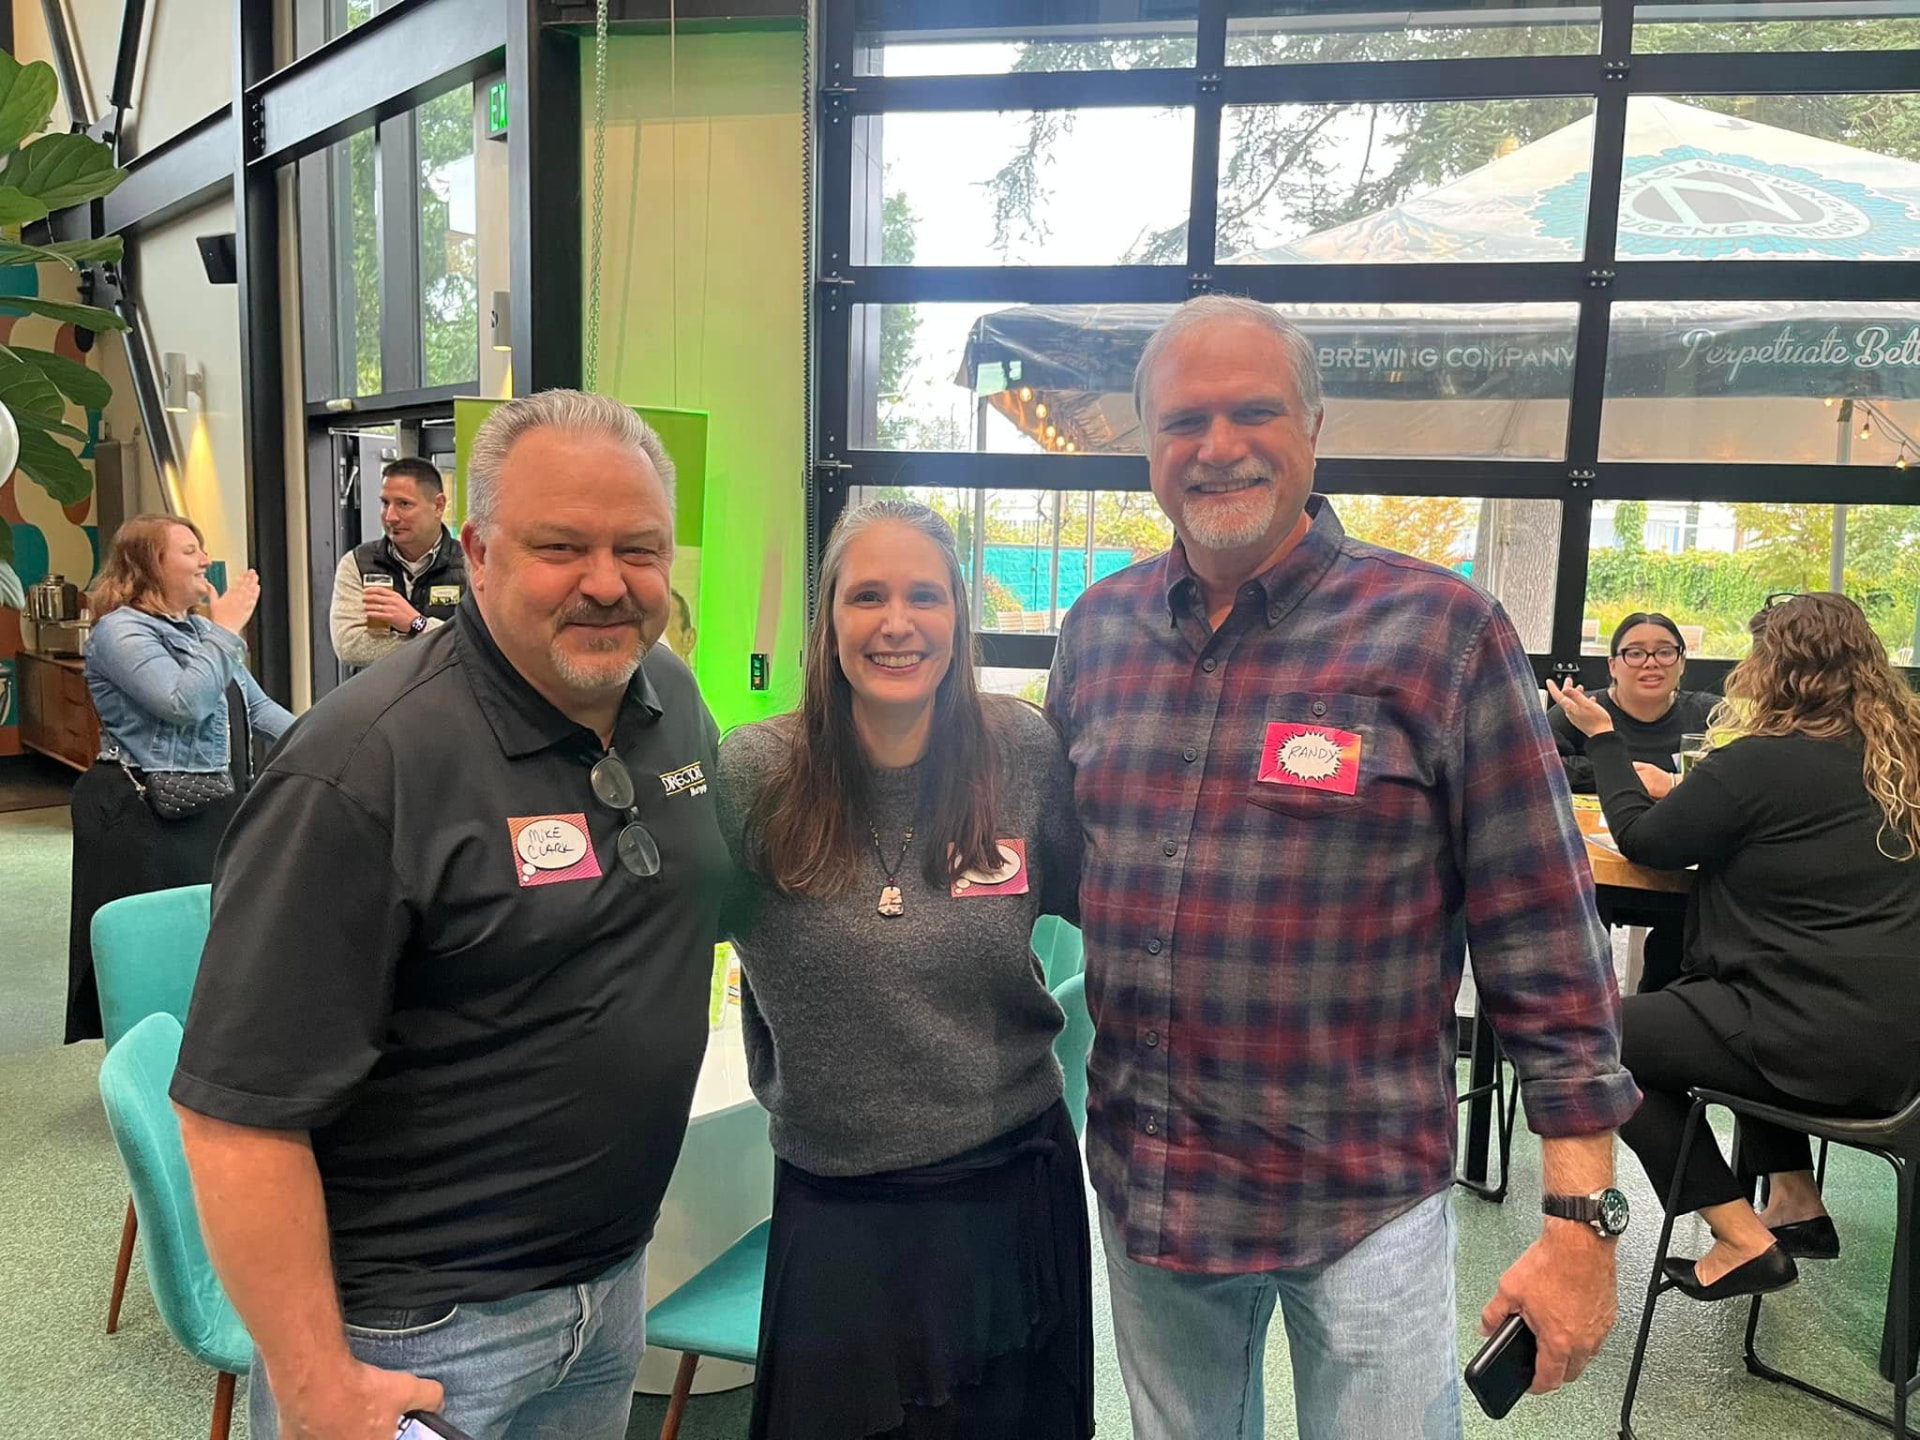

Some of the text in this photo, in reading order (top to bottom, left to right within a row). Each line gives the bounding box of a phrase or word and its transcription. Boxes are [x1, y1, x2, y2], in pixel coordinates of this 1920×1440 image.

[1318, 346, 1575, 369] BREWING COMPANY
[1678, 325, 1850, 383] Perpetuate
[1288, 745, 1338, 763] RANDY
[527, 842, 576, 860] CLARK
